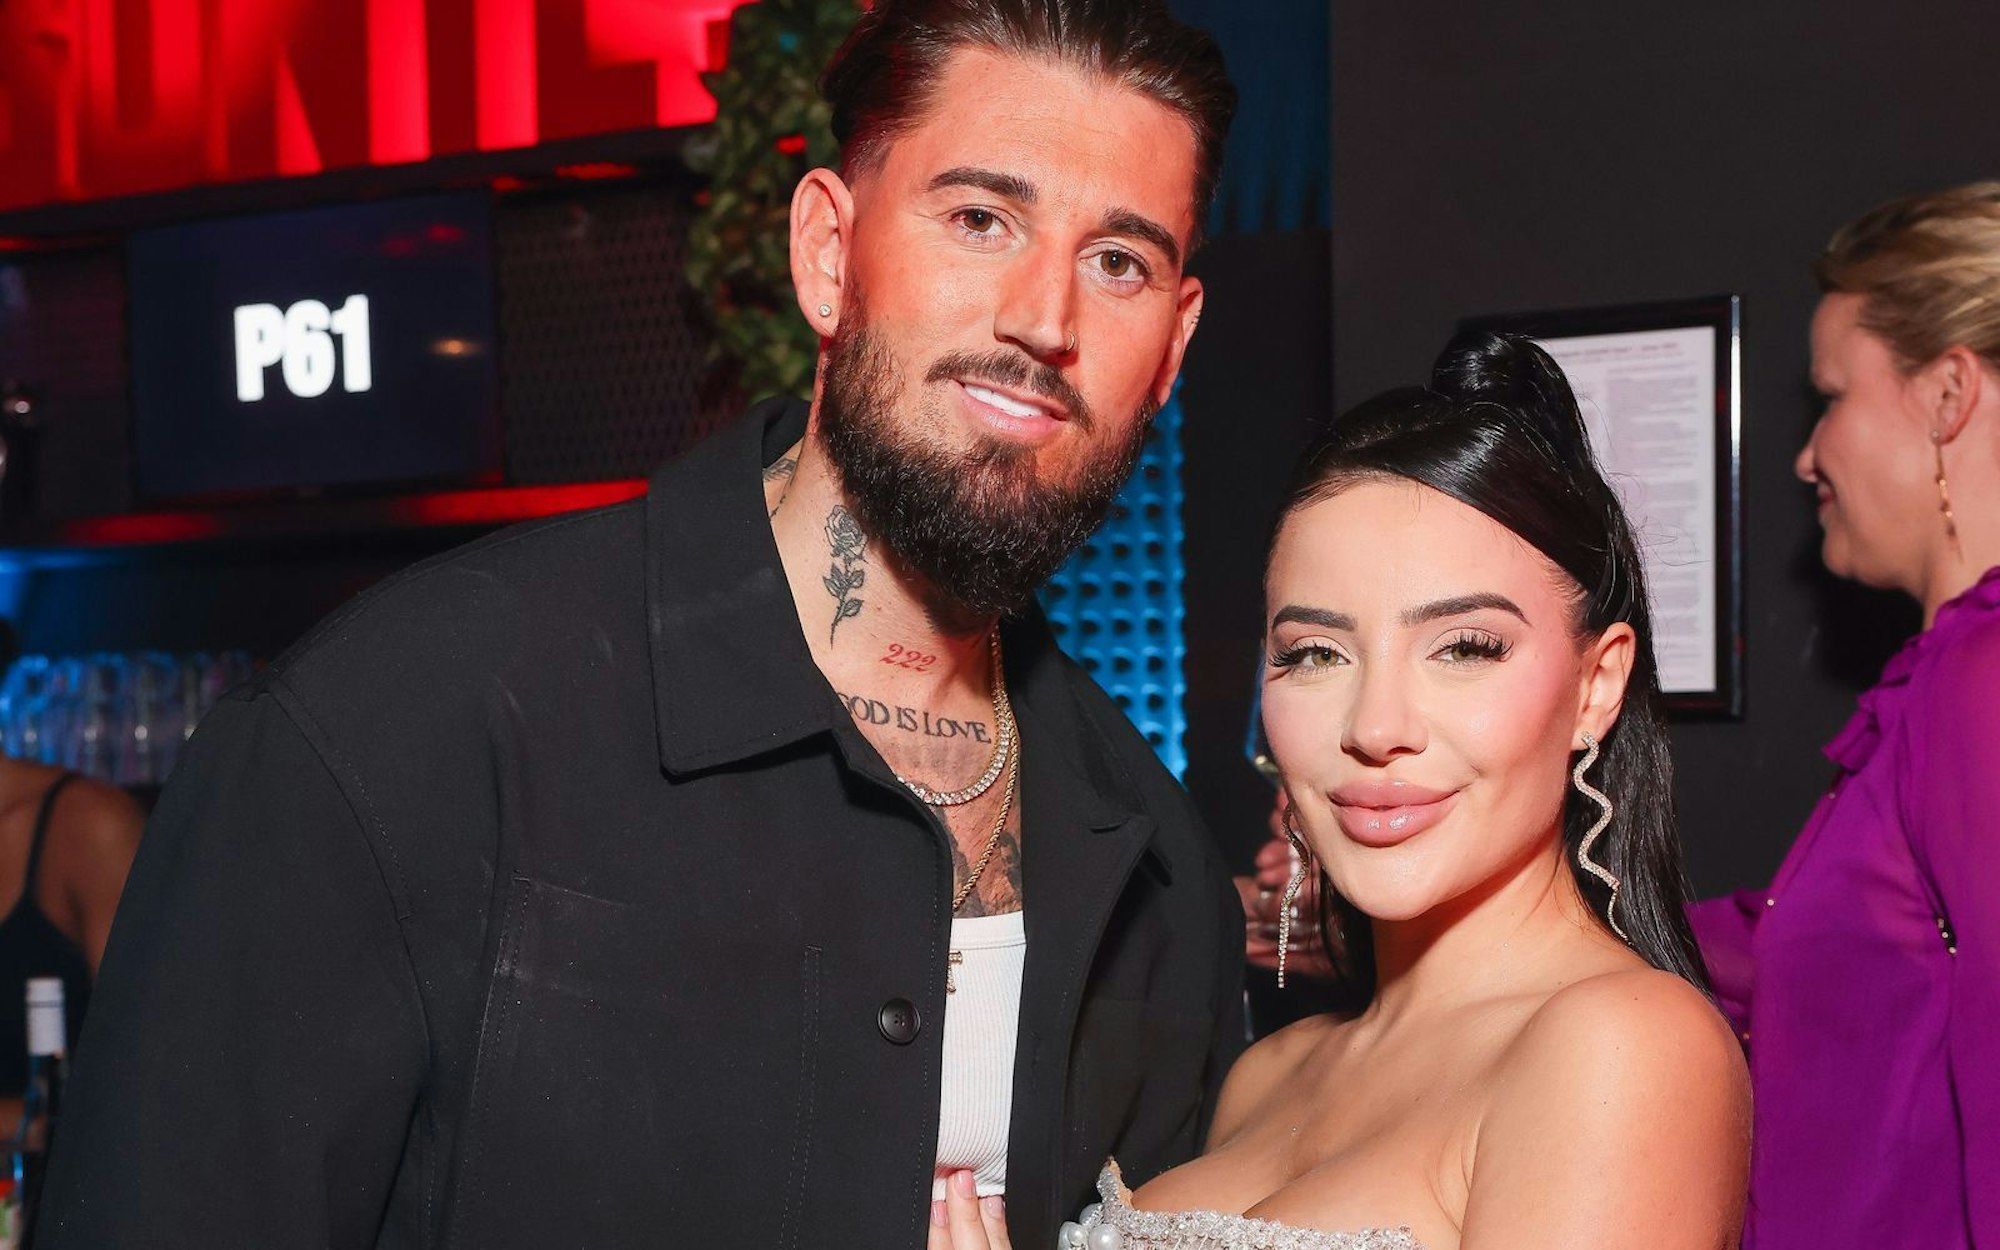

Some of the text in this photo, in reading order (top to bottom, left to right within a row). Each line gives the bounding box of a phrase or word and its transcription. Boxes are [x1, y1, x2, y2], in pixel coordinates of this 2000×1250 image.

[233, 293, 372, 402] P61
[880, 643, 937, 672] 222
[895, 705, 918, 732] IS
[923, 711, 992, 744] LOVE
